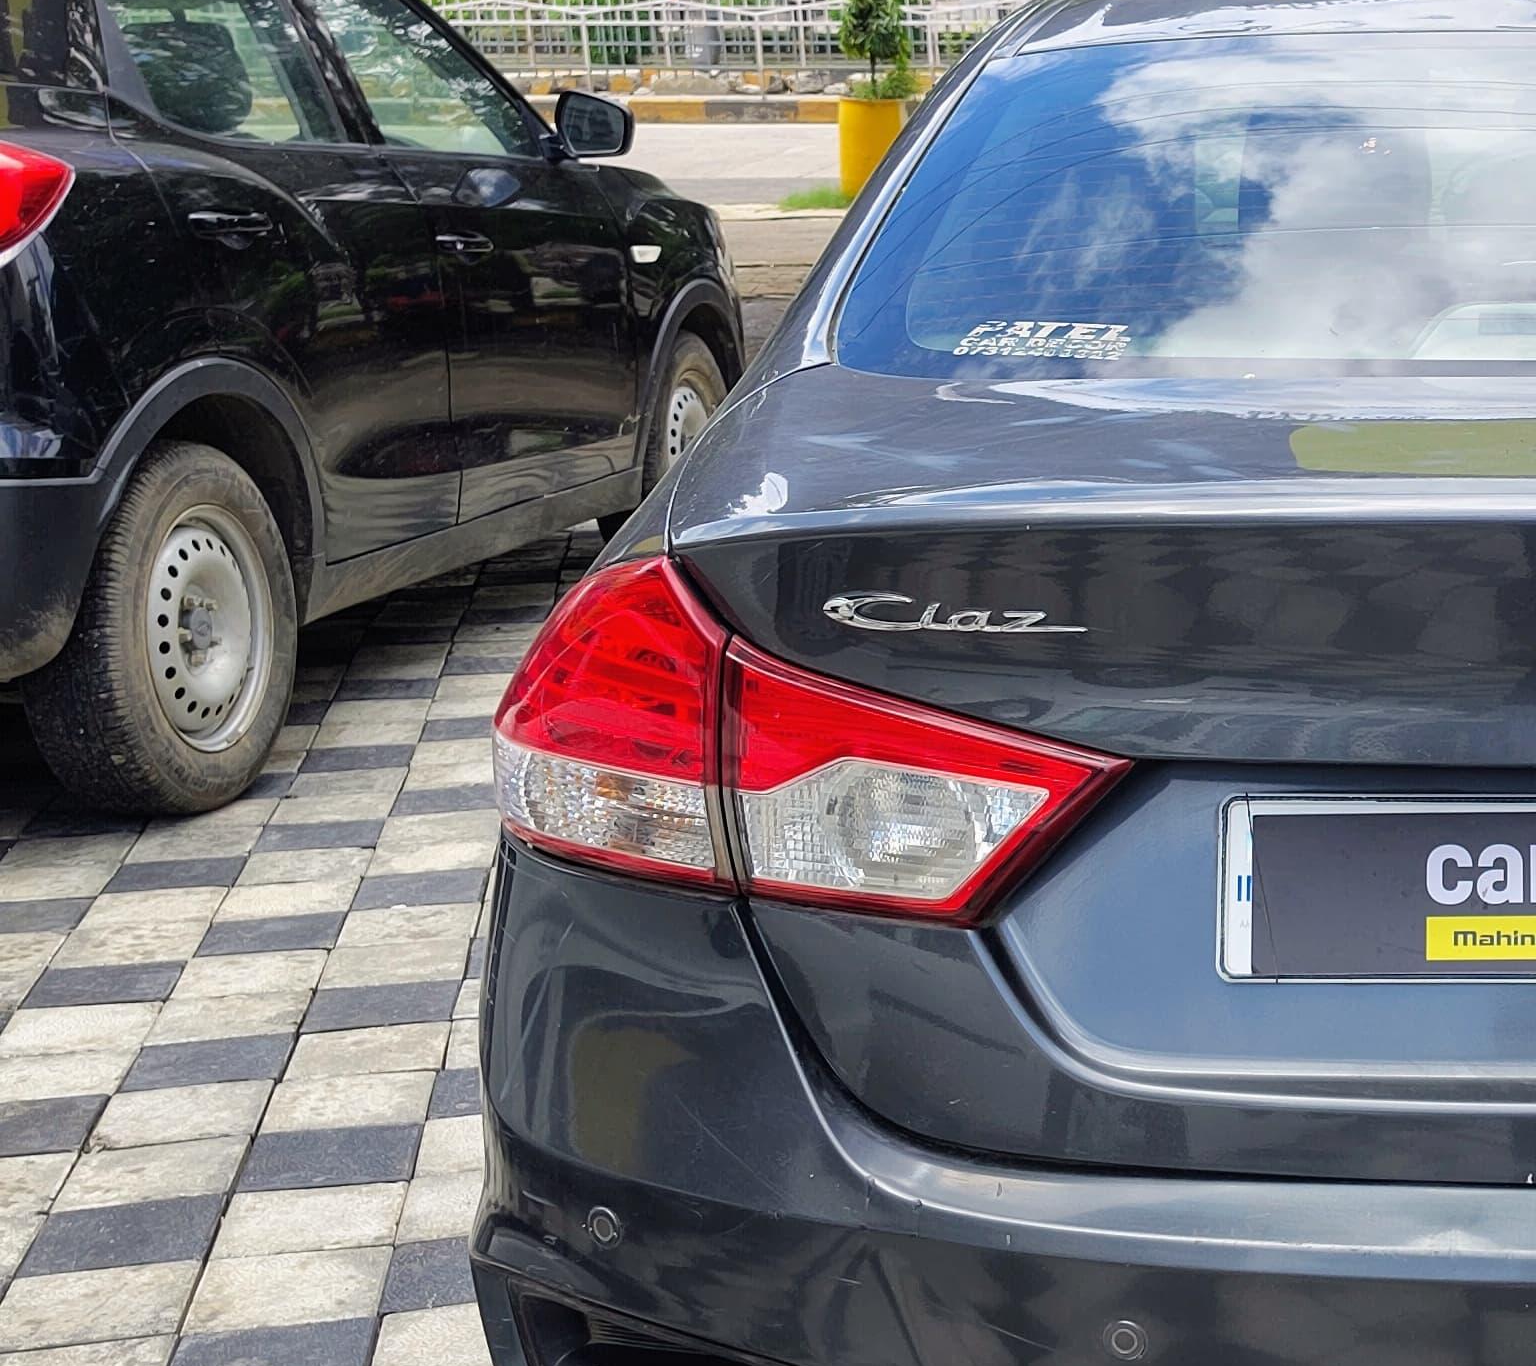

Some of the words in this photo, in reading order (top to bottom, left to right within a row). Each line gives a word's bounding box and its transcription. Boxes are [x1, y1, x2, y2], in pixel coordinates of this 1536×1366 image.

[967, 320, 1132, 342] PATEL
[960, 337, 1018, 347] CAR
[1025, 338, 1128, 352] DECOR
[822, 591, 1089, 633] Ciaz
